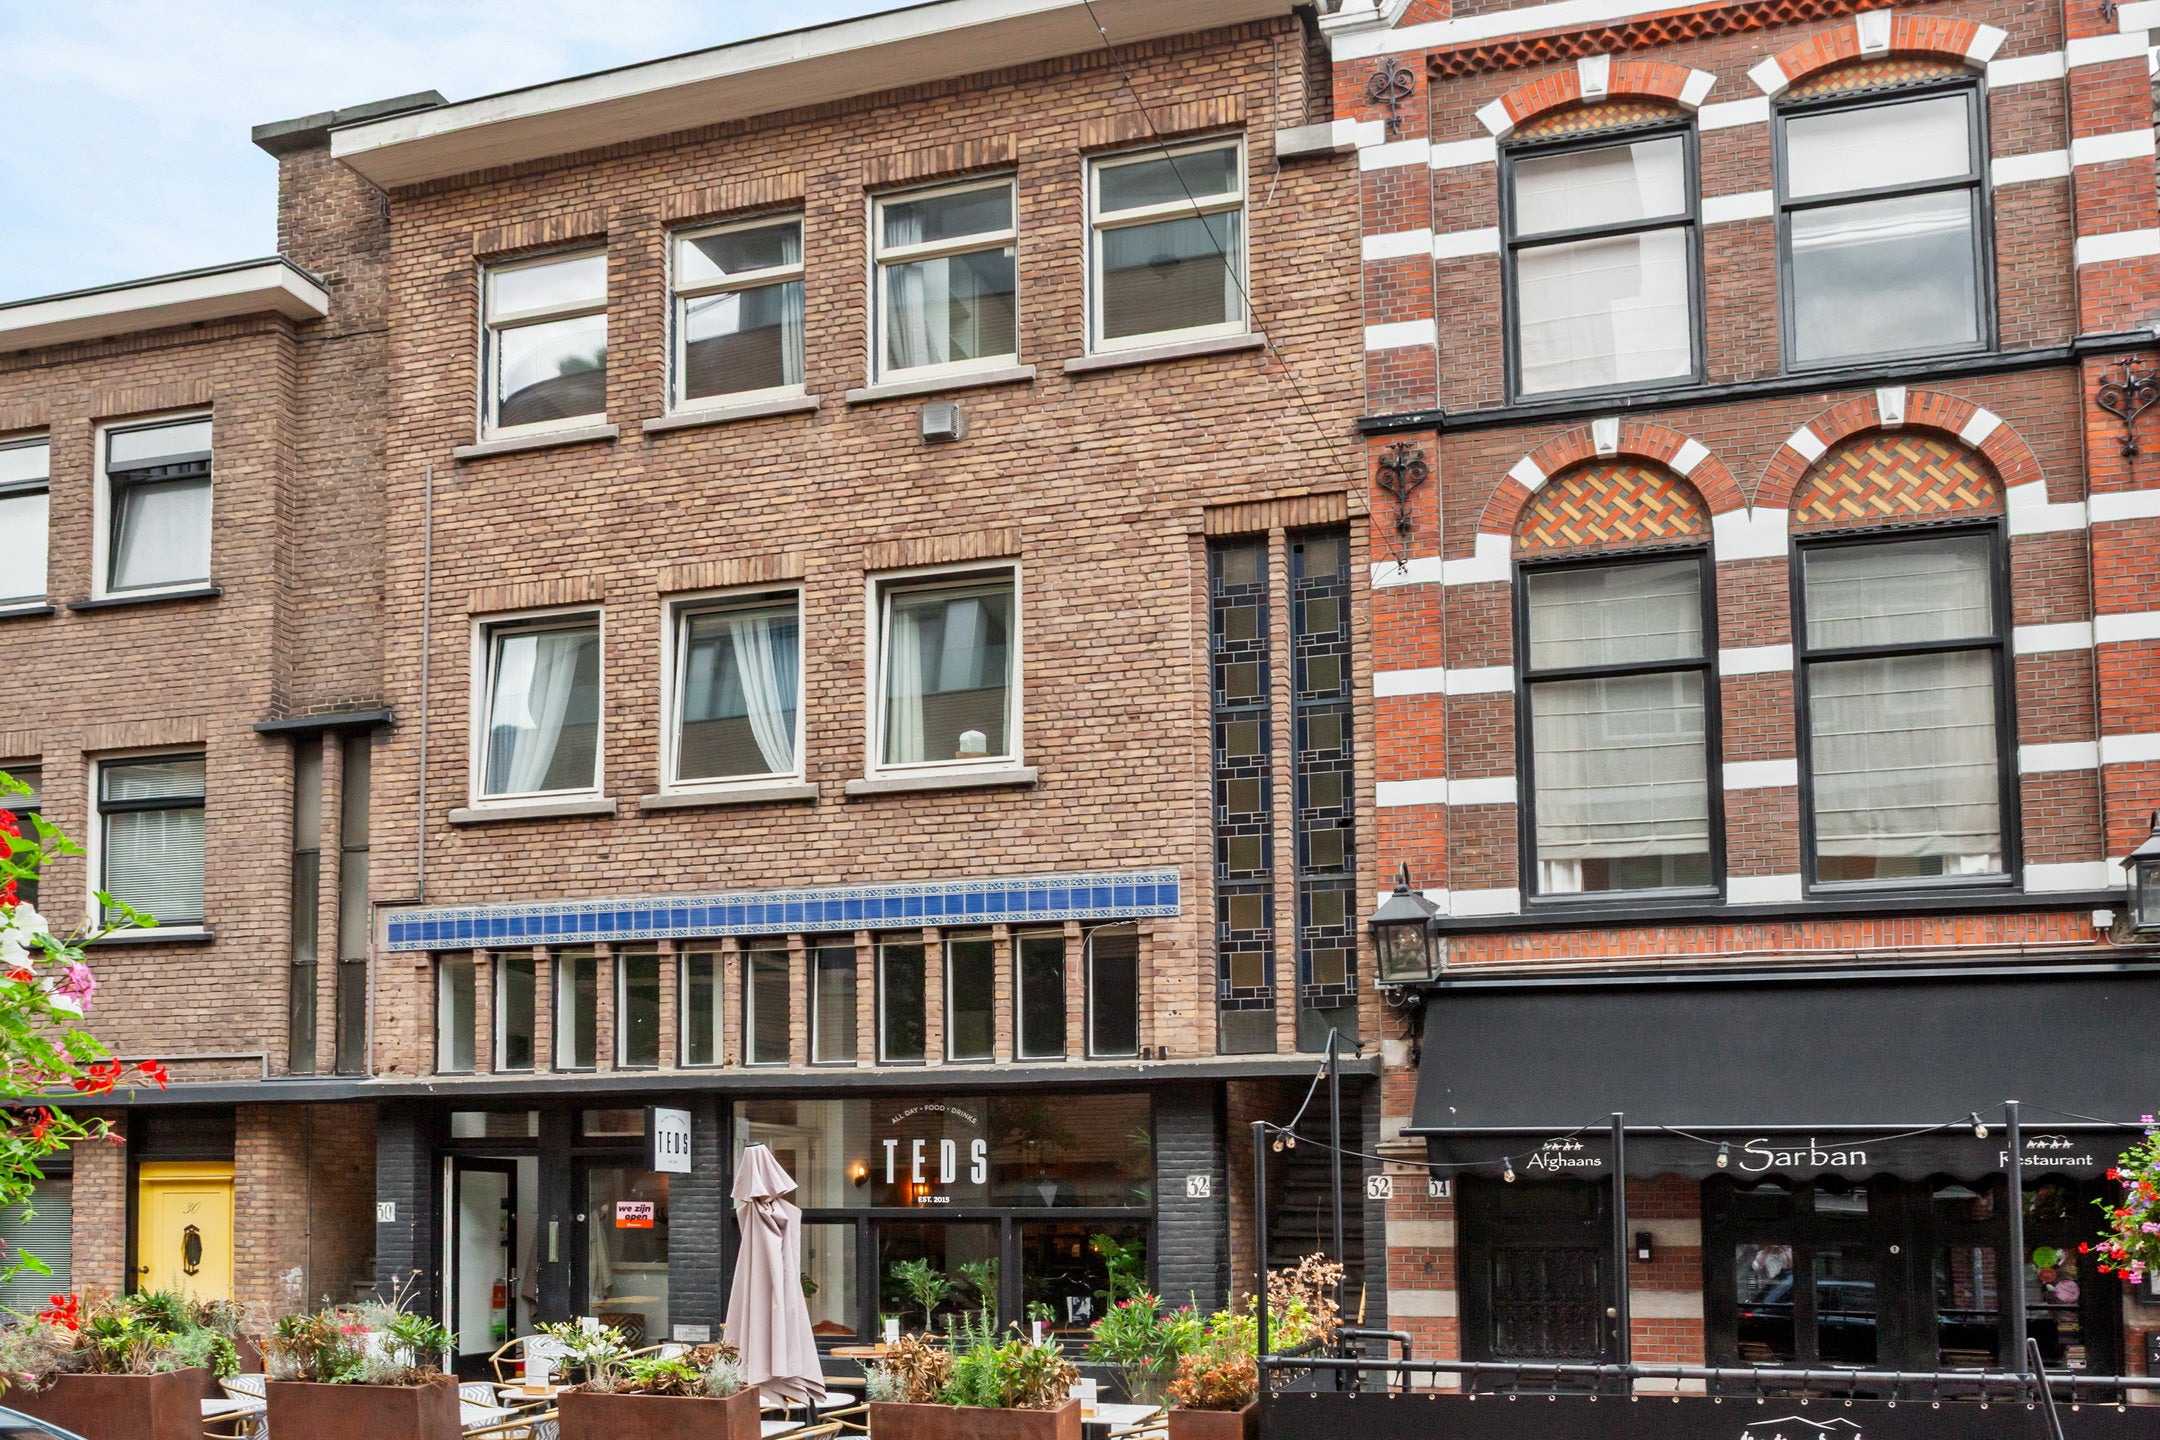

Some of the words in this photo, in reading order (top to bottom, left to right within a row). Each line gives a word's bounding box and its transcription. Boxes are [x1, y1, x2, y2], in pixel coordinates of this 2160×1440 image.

[891, 1113, 905, 1125] ALL
[904, 1106, 919, 1117] DAY
[924, 1104, 946, 1112] FOOD
[950, 1107, 978, 1125] DRINKS
[658, 1130, 688, 1155] TEDS
[882, 1138, 987, 1184] TEDS
[1526, 1151, 1602, 1172] Afghaans
[1739, 1137, 1867, 1172] Sarban
[618, 1205, 632, 1213] we
[634, 1204, 651, 1214] zijn
[625, 1214, 648, 1222] open
